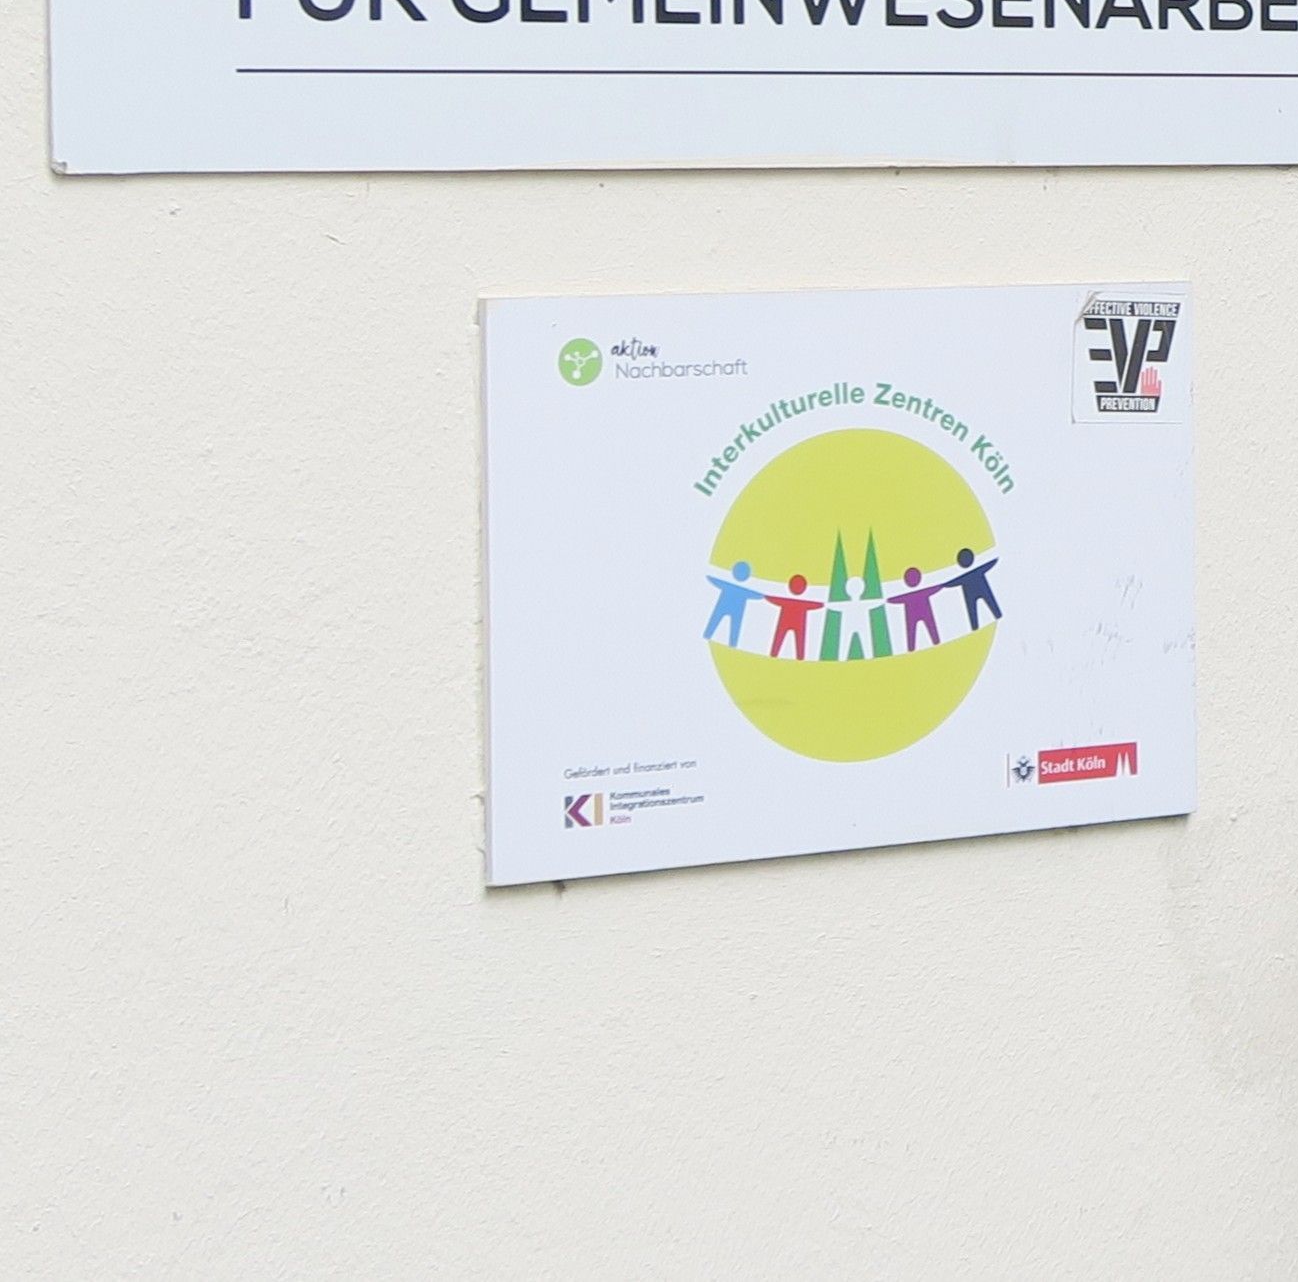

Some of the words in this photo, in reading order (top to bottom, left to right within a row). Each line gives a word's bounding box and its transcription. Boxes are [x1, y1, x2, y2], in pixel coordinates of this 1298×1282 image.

[1134, 302, 1178, 317] VIOLENCE
[610, 337, 659, 361] aktion
[615, 359, 749, 379] Nachbarschaft
[1100, 397, 1156, 411] PREVENTION
[693, 382, 866, 497] Interkulturelle
[873, 383, 970, 442] Zentren
[970, 435, 1016, 495] Köln
[563, 766, 610, 779] Gefördert
[612, 762, 631, 775] und
[633, 761, 678, 773] finanziert
[1040, 758, 1074, 775] Stadt
[1076, 755, 1106, 771] Köln
[609, 787, 671, 800] Kommunales
[609, 795, 705, 811] Integrationszentrum
[609, 814, 632, 825] Köln
